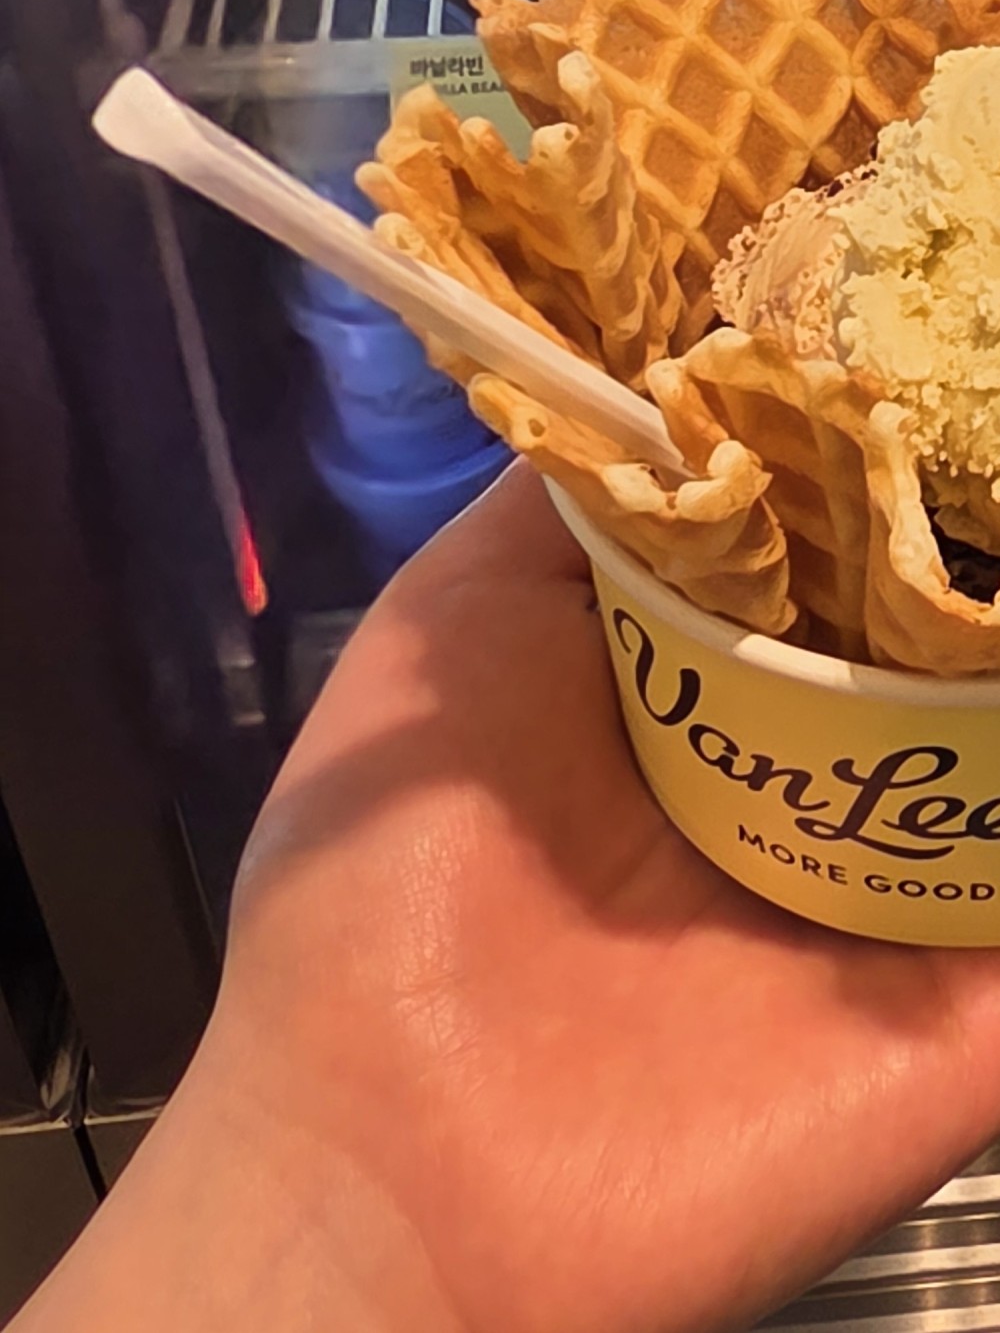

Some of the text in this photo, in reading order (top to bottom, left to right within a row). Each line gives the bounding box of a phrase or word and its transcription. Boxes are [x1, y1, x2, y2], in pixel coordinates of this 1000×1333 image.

[611, 607, 830, 811] Van
[738, 823, 849, 887] MORE
[864, 873, 996, 901] GOOD
